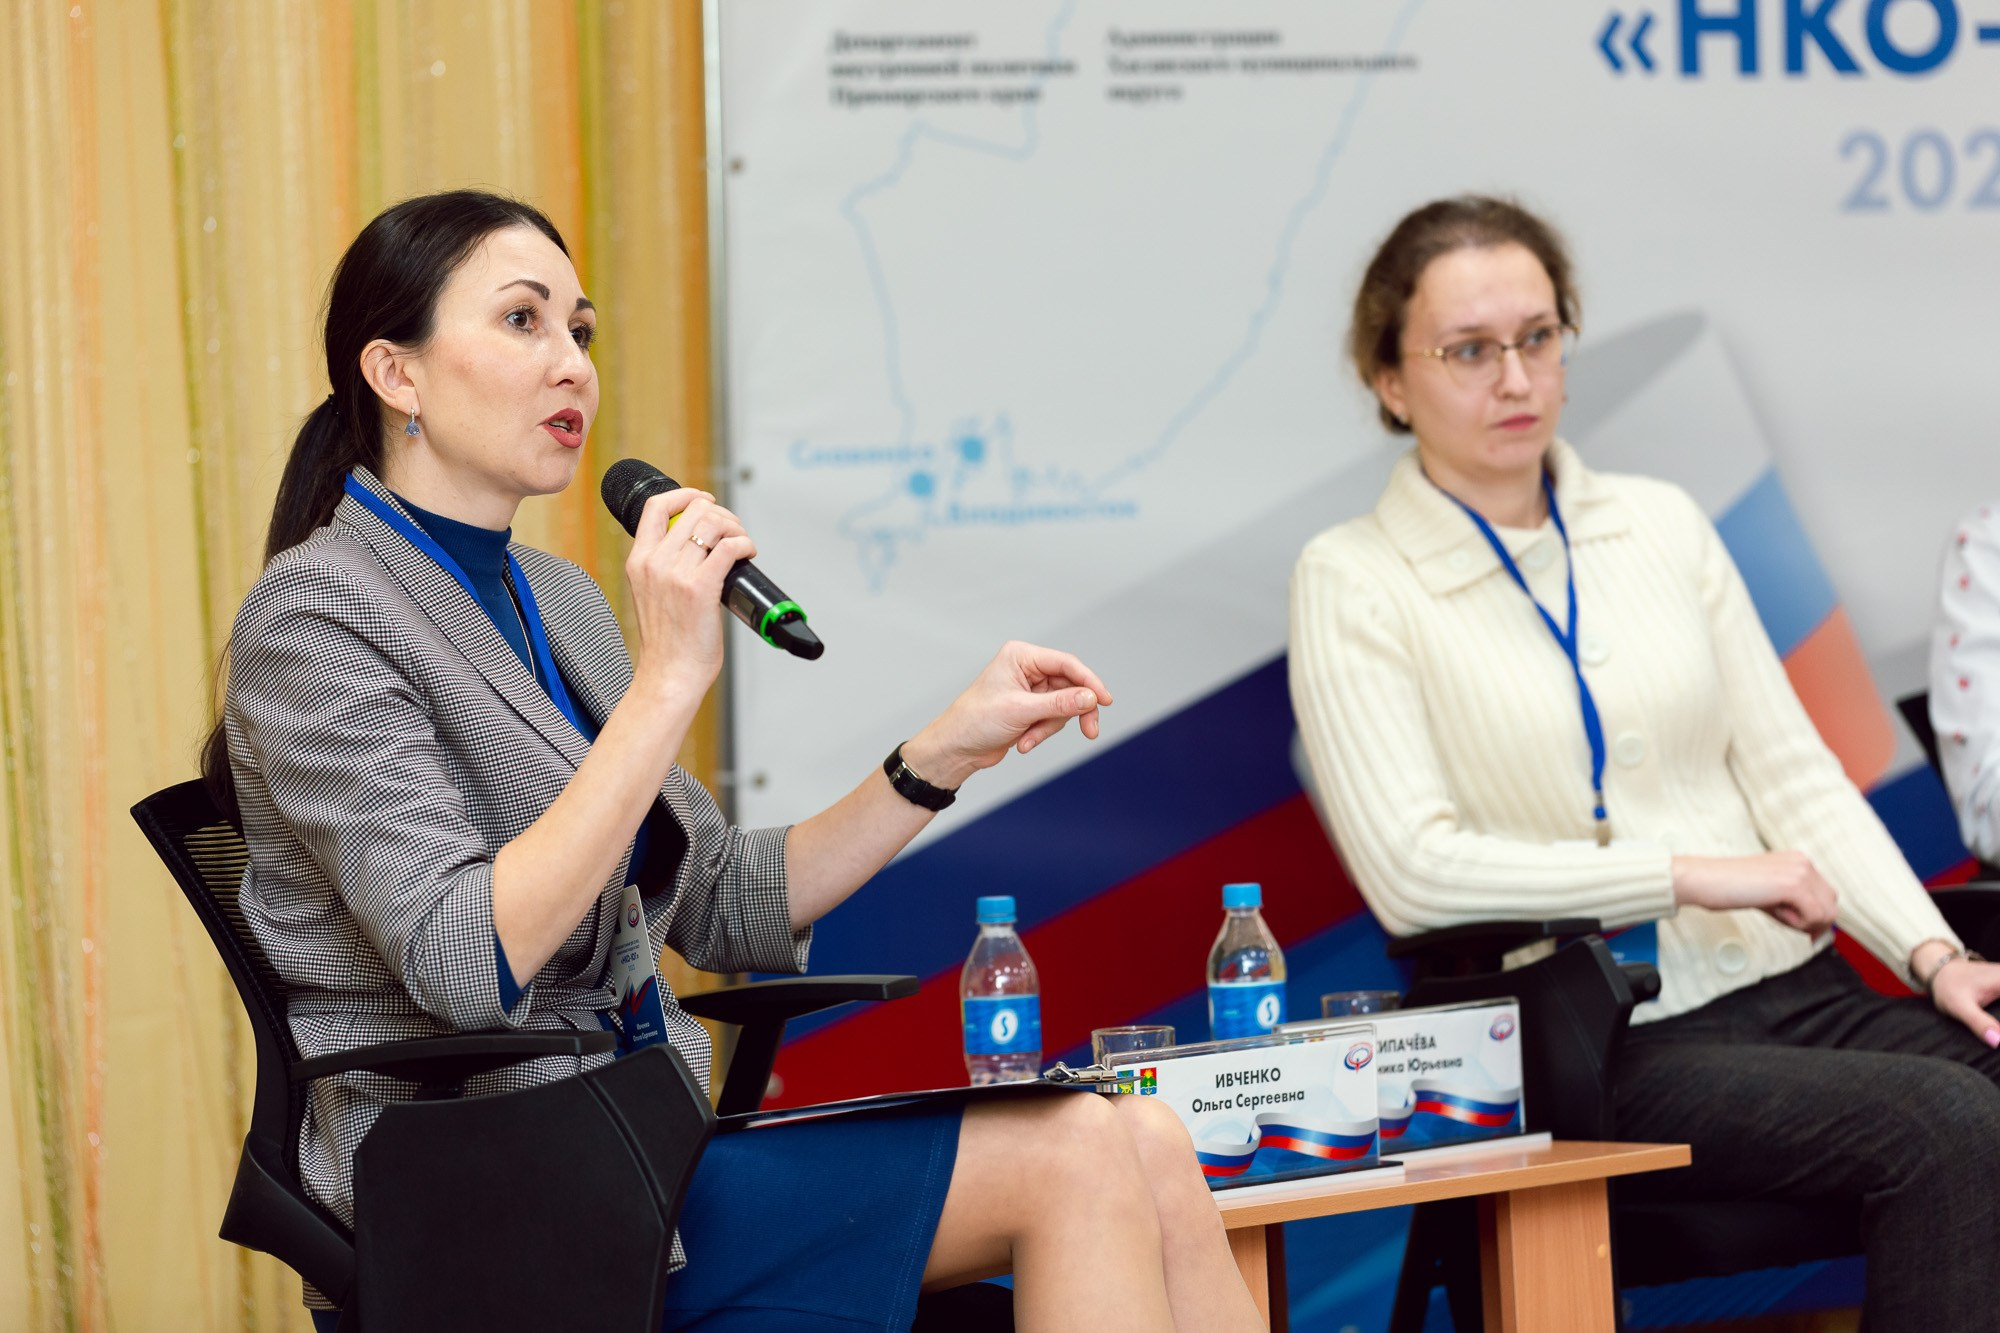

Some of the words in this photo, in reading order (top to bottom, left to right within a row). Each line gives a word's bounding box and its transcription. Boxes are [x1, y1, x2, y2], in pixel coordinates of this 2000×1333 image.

[1407, 1057, 1463, 1075] Юрьевна
[1215, 1067, 1281, 1088] ИВЧЕНКО
[1191, 1098, 1232, 1113] Ольга
[1236, 1090, 1305, 1110] Сергеевна
